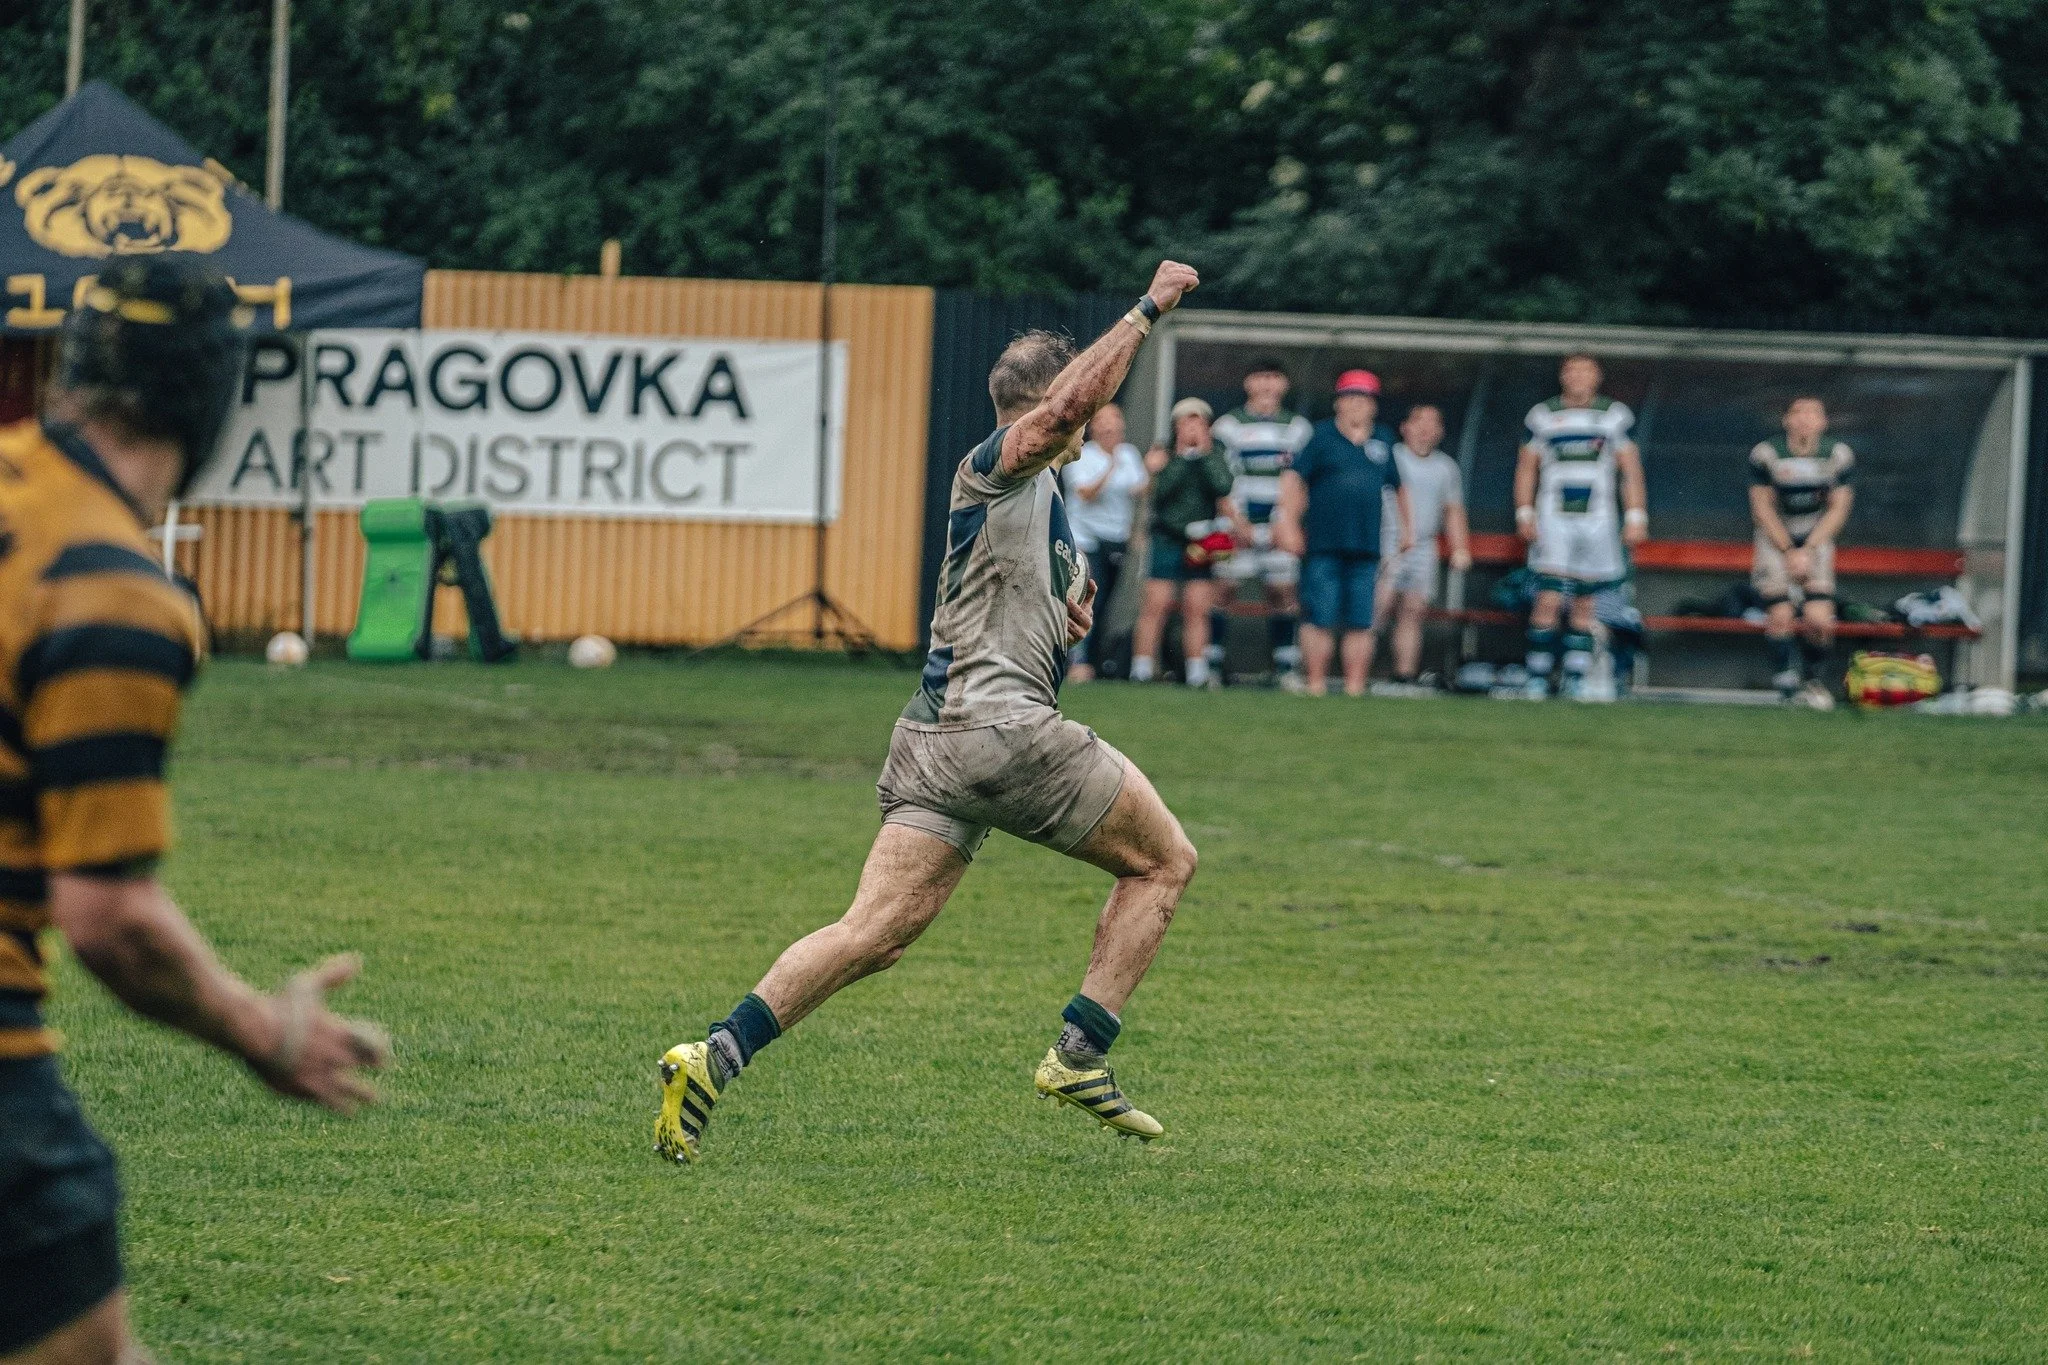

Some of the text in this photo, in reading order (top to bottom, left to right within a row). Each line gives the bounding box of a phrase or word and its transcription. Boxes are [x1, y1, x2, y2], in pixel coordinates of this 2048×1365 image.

[241, 336, 750, 418] PRAGOVKA
[229, 427, 752, 505] ART DISTRICT
